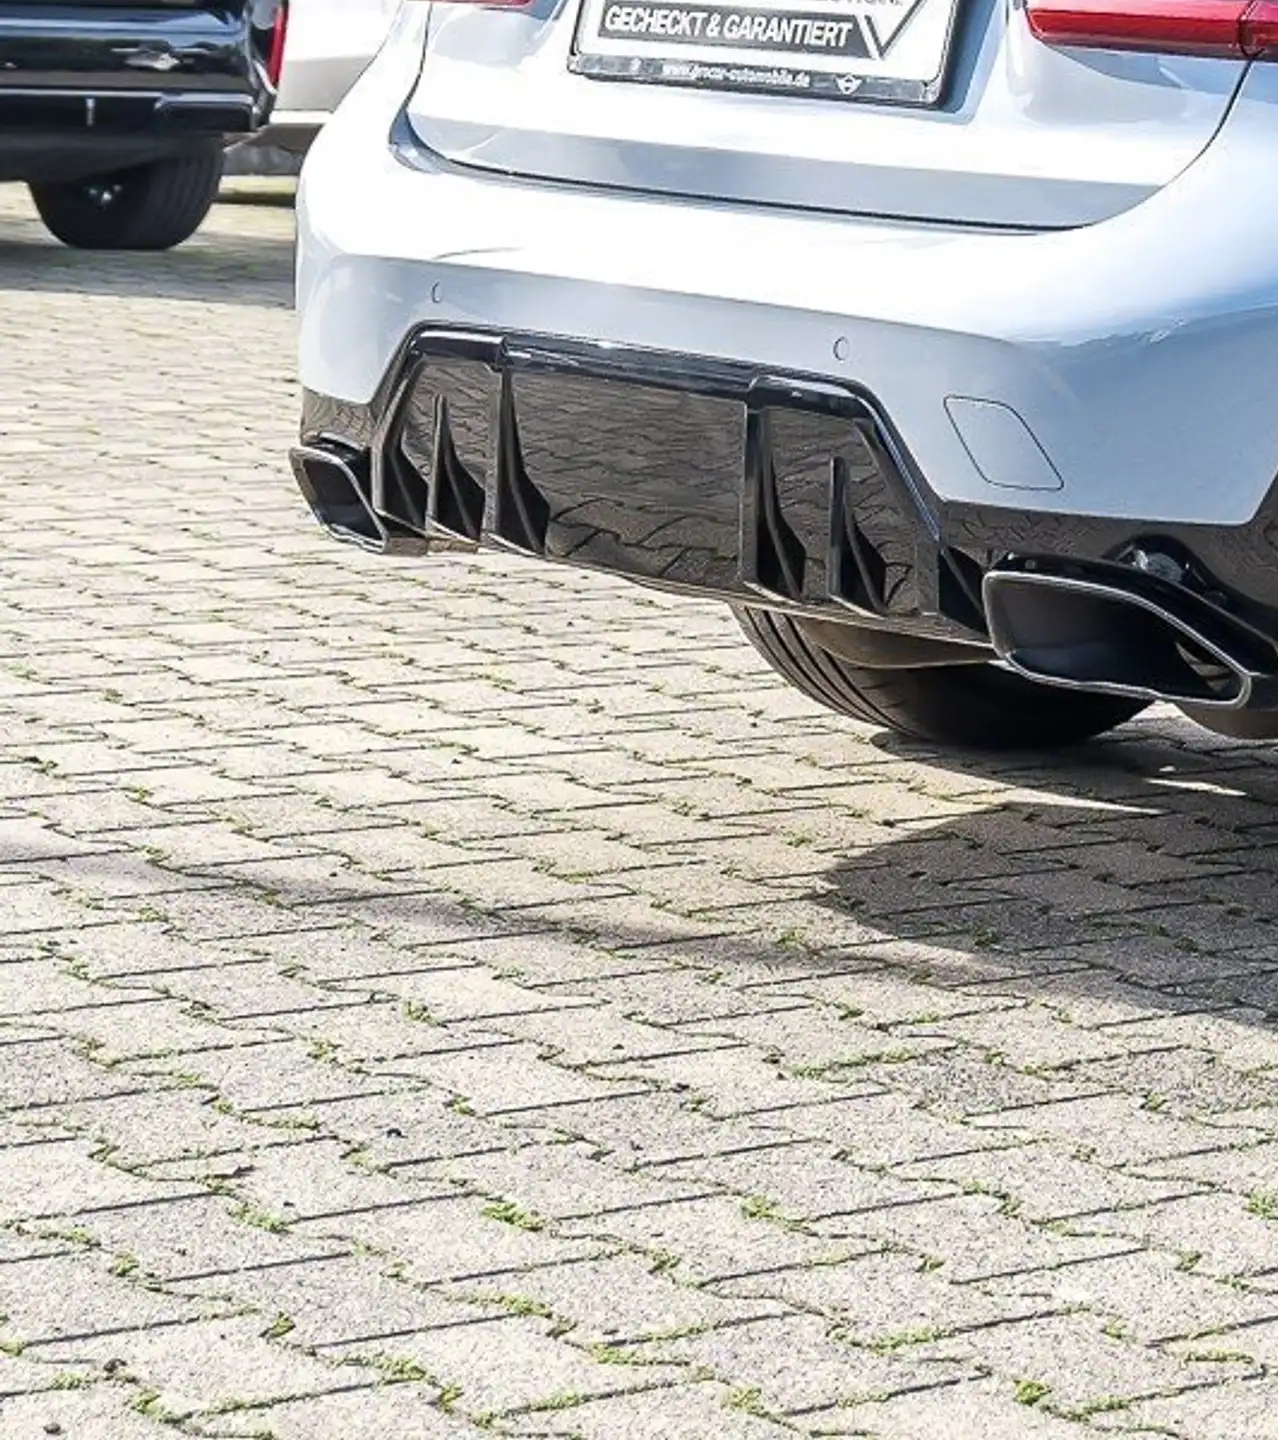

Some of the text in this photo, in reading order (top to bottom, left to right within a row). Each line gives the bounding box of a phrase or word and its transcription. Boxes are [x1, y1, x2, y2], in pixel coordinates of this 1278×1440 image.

[604, 4, 853, 48] GECHECKT & GARANTIERT
